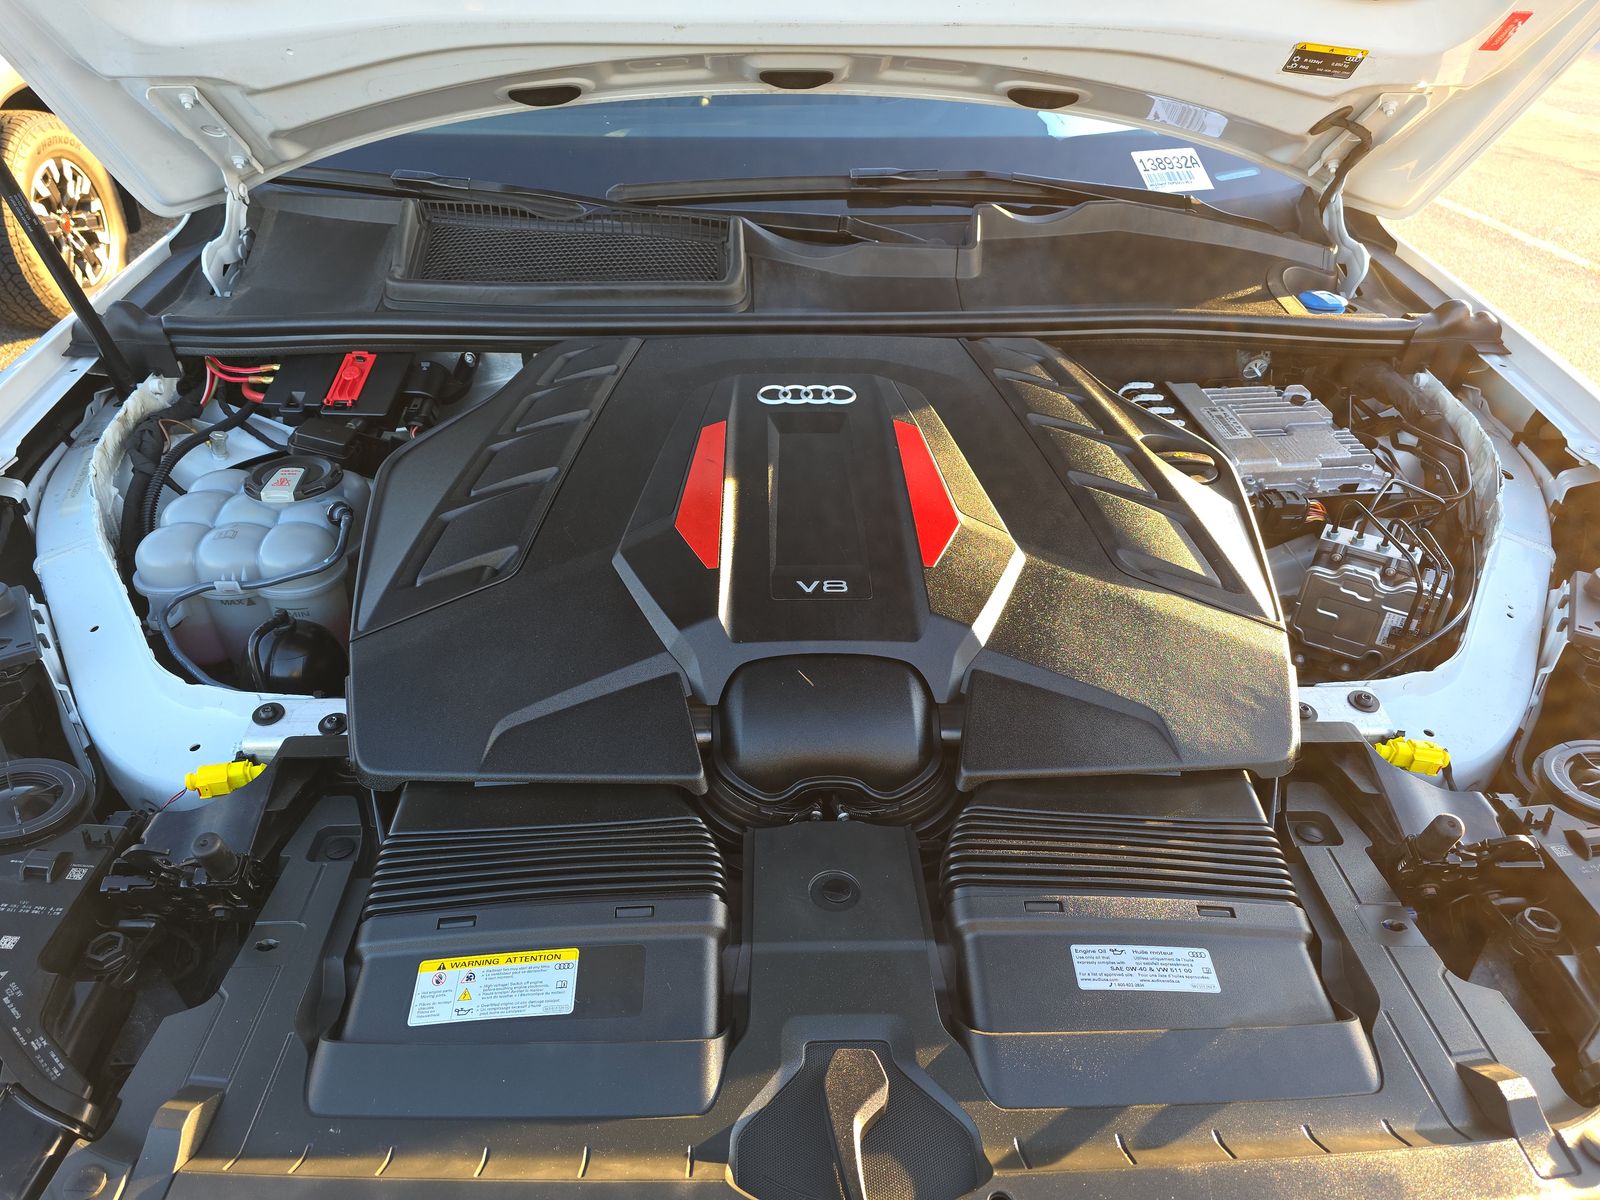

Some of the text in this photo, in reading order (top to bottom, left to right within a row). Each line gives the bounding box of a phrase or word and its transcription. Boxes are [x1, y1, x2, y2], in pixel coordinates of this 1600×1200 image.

[1140, 155, 1200, 172] 138932A
[796, 580, 848, 592] V8
[450, 954, 562, 968] WARNING ATTENTION
